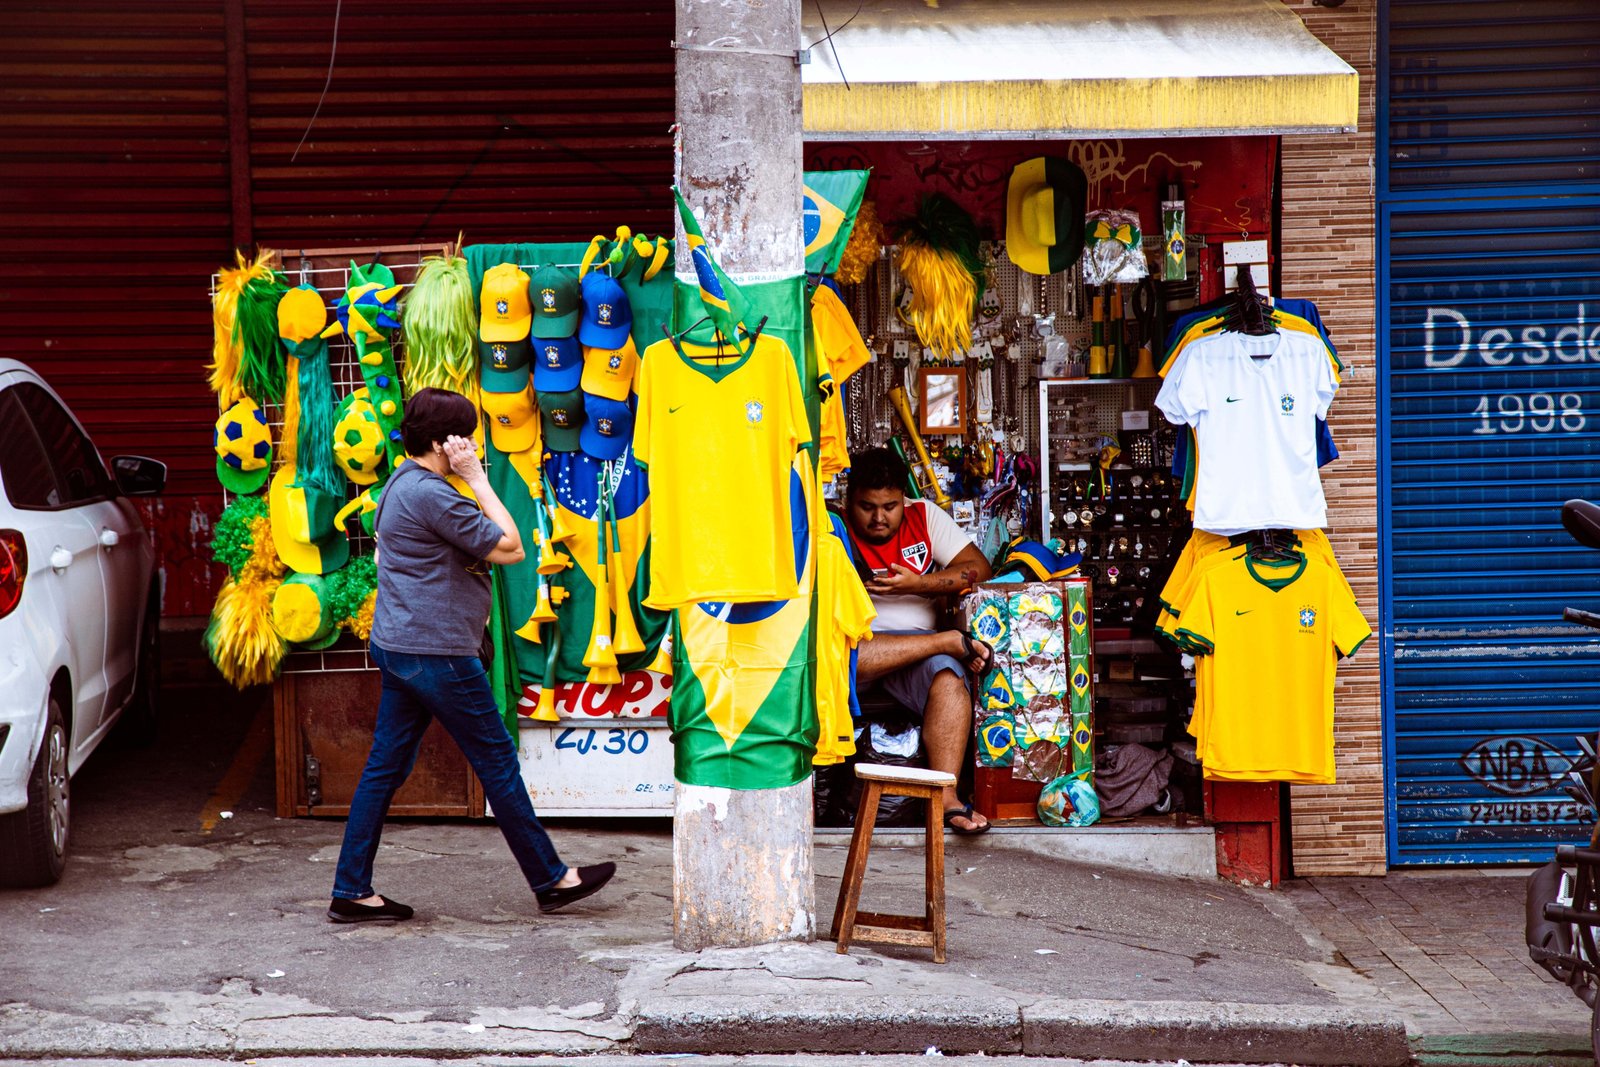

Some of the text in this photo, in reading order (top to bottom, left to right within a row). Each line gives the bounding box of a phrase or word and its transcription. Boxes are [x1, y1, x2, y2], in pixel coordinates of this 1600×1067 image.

[1472, 393, 1586, 434] 1998
[904, 544, 925, 557] SPFC
[1479, 740, 1550, 788] NBA
